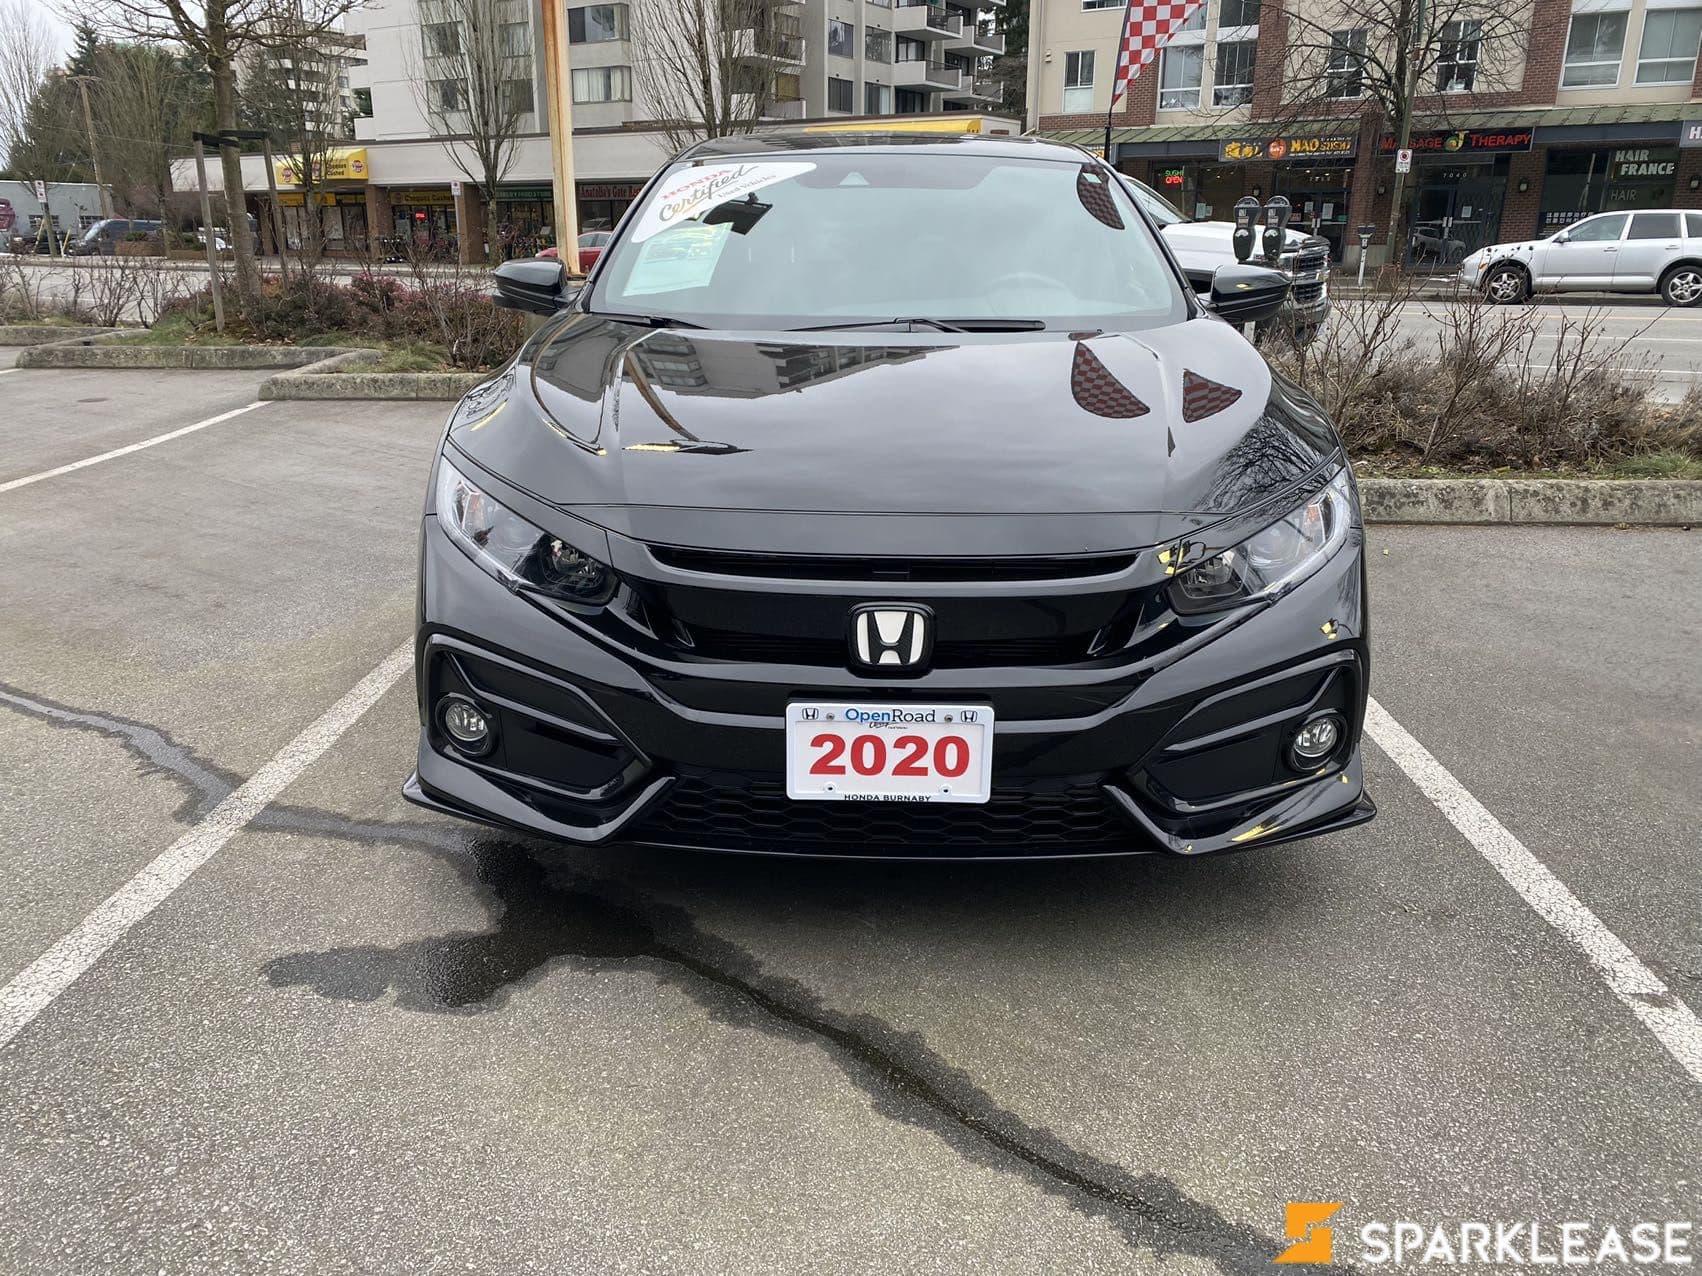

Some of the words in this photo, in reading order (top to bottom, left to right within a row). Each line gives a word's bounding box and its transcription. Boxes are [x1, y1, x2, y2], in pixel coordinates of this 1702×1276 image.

[1470, 133, 1532, 147] THERAPY
[1615, 149, 1650, 162] HAIR
[1620, 162, 1675, 175] FRANCE
[662, 169, 735, 200] HONDA
[659, 164, 760, 221] Certified
[1610, 189, 1637, 200] HAIR
[845, 708, 936, 724] OpenRoad
[808, 733, 970, 778] 2020
[883, 794, 932, 803] BURNABY
